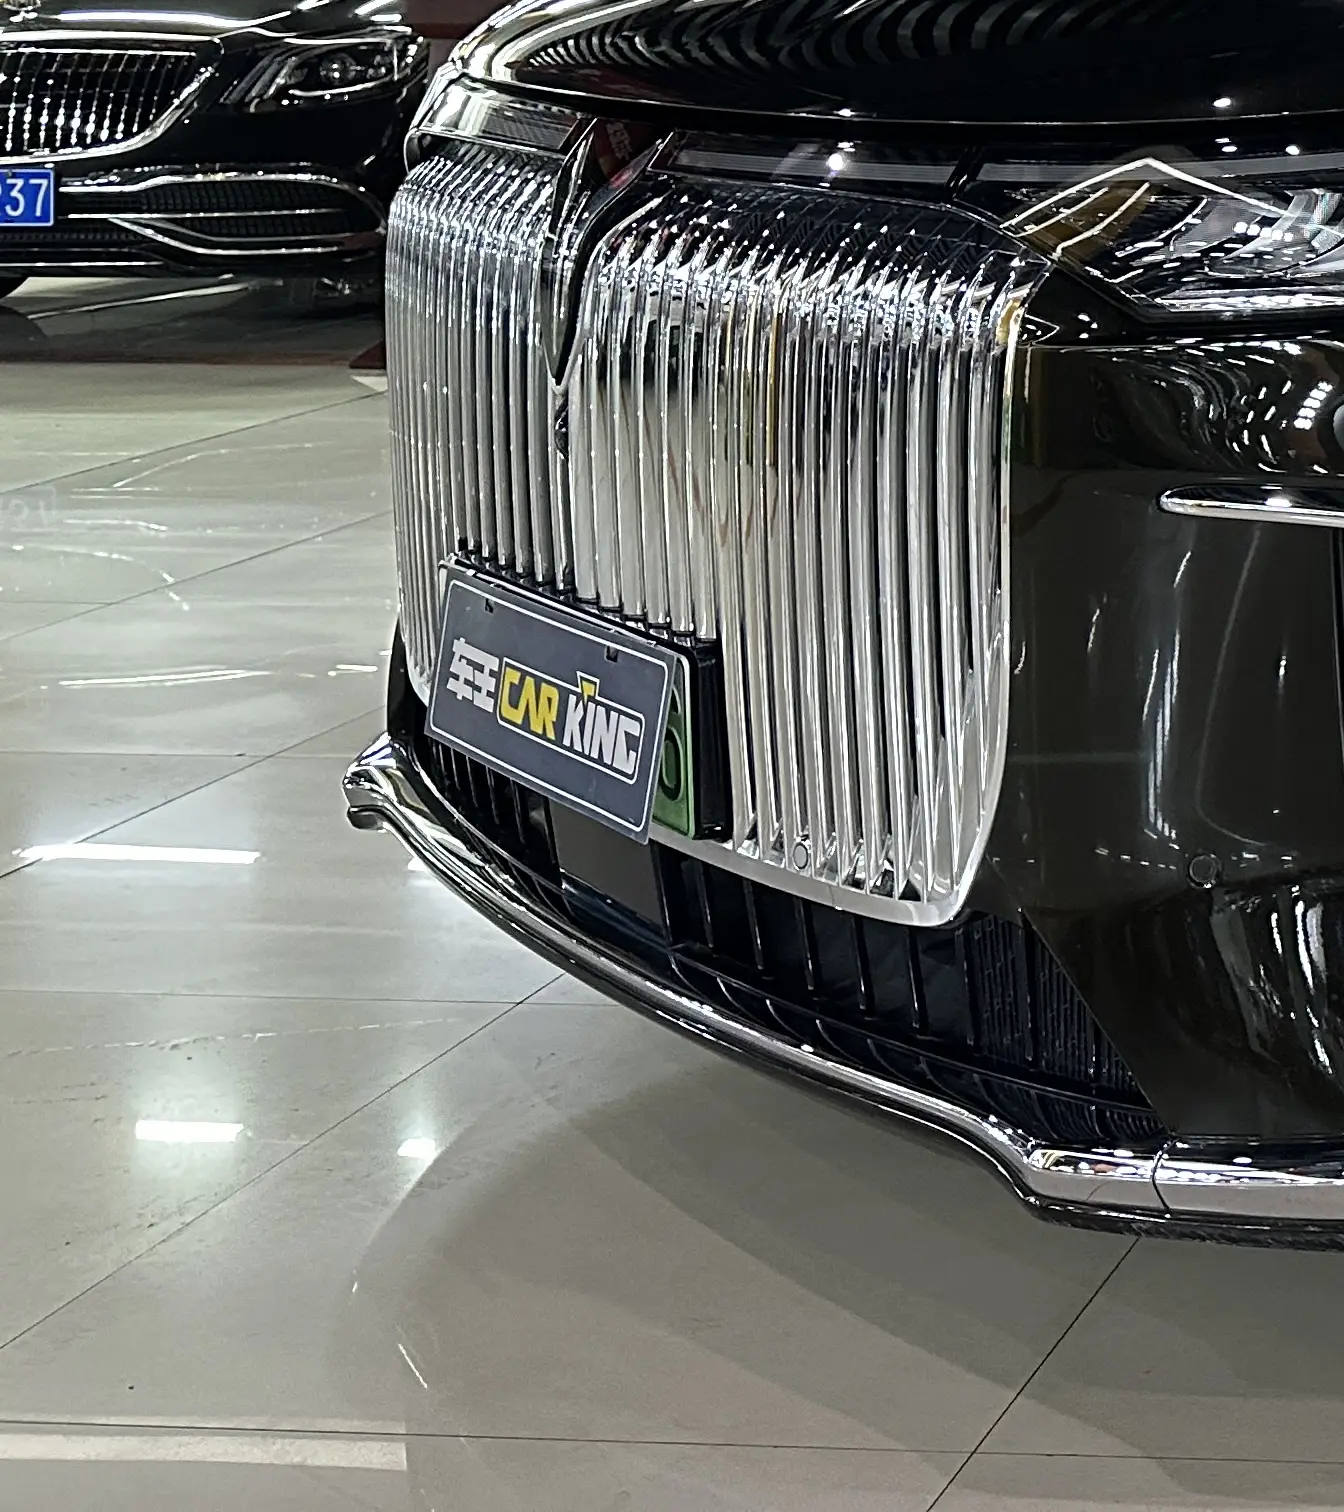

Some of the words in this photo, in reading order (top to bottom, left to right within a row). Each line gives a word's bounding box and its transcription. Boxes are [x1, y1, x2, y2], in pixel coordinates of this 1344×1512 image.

[0, 178, 49, 217] 37
[500, 666, 560, 741] CAR
[563, 678, 642, 776] KING
